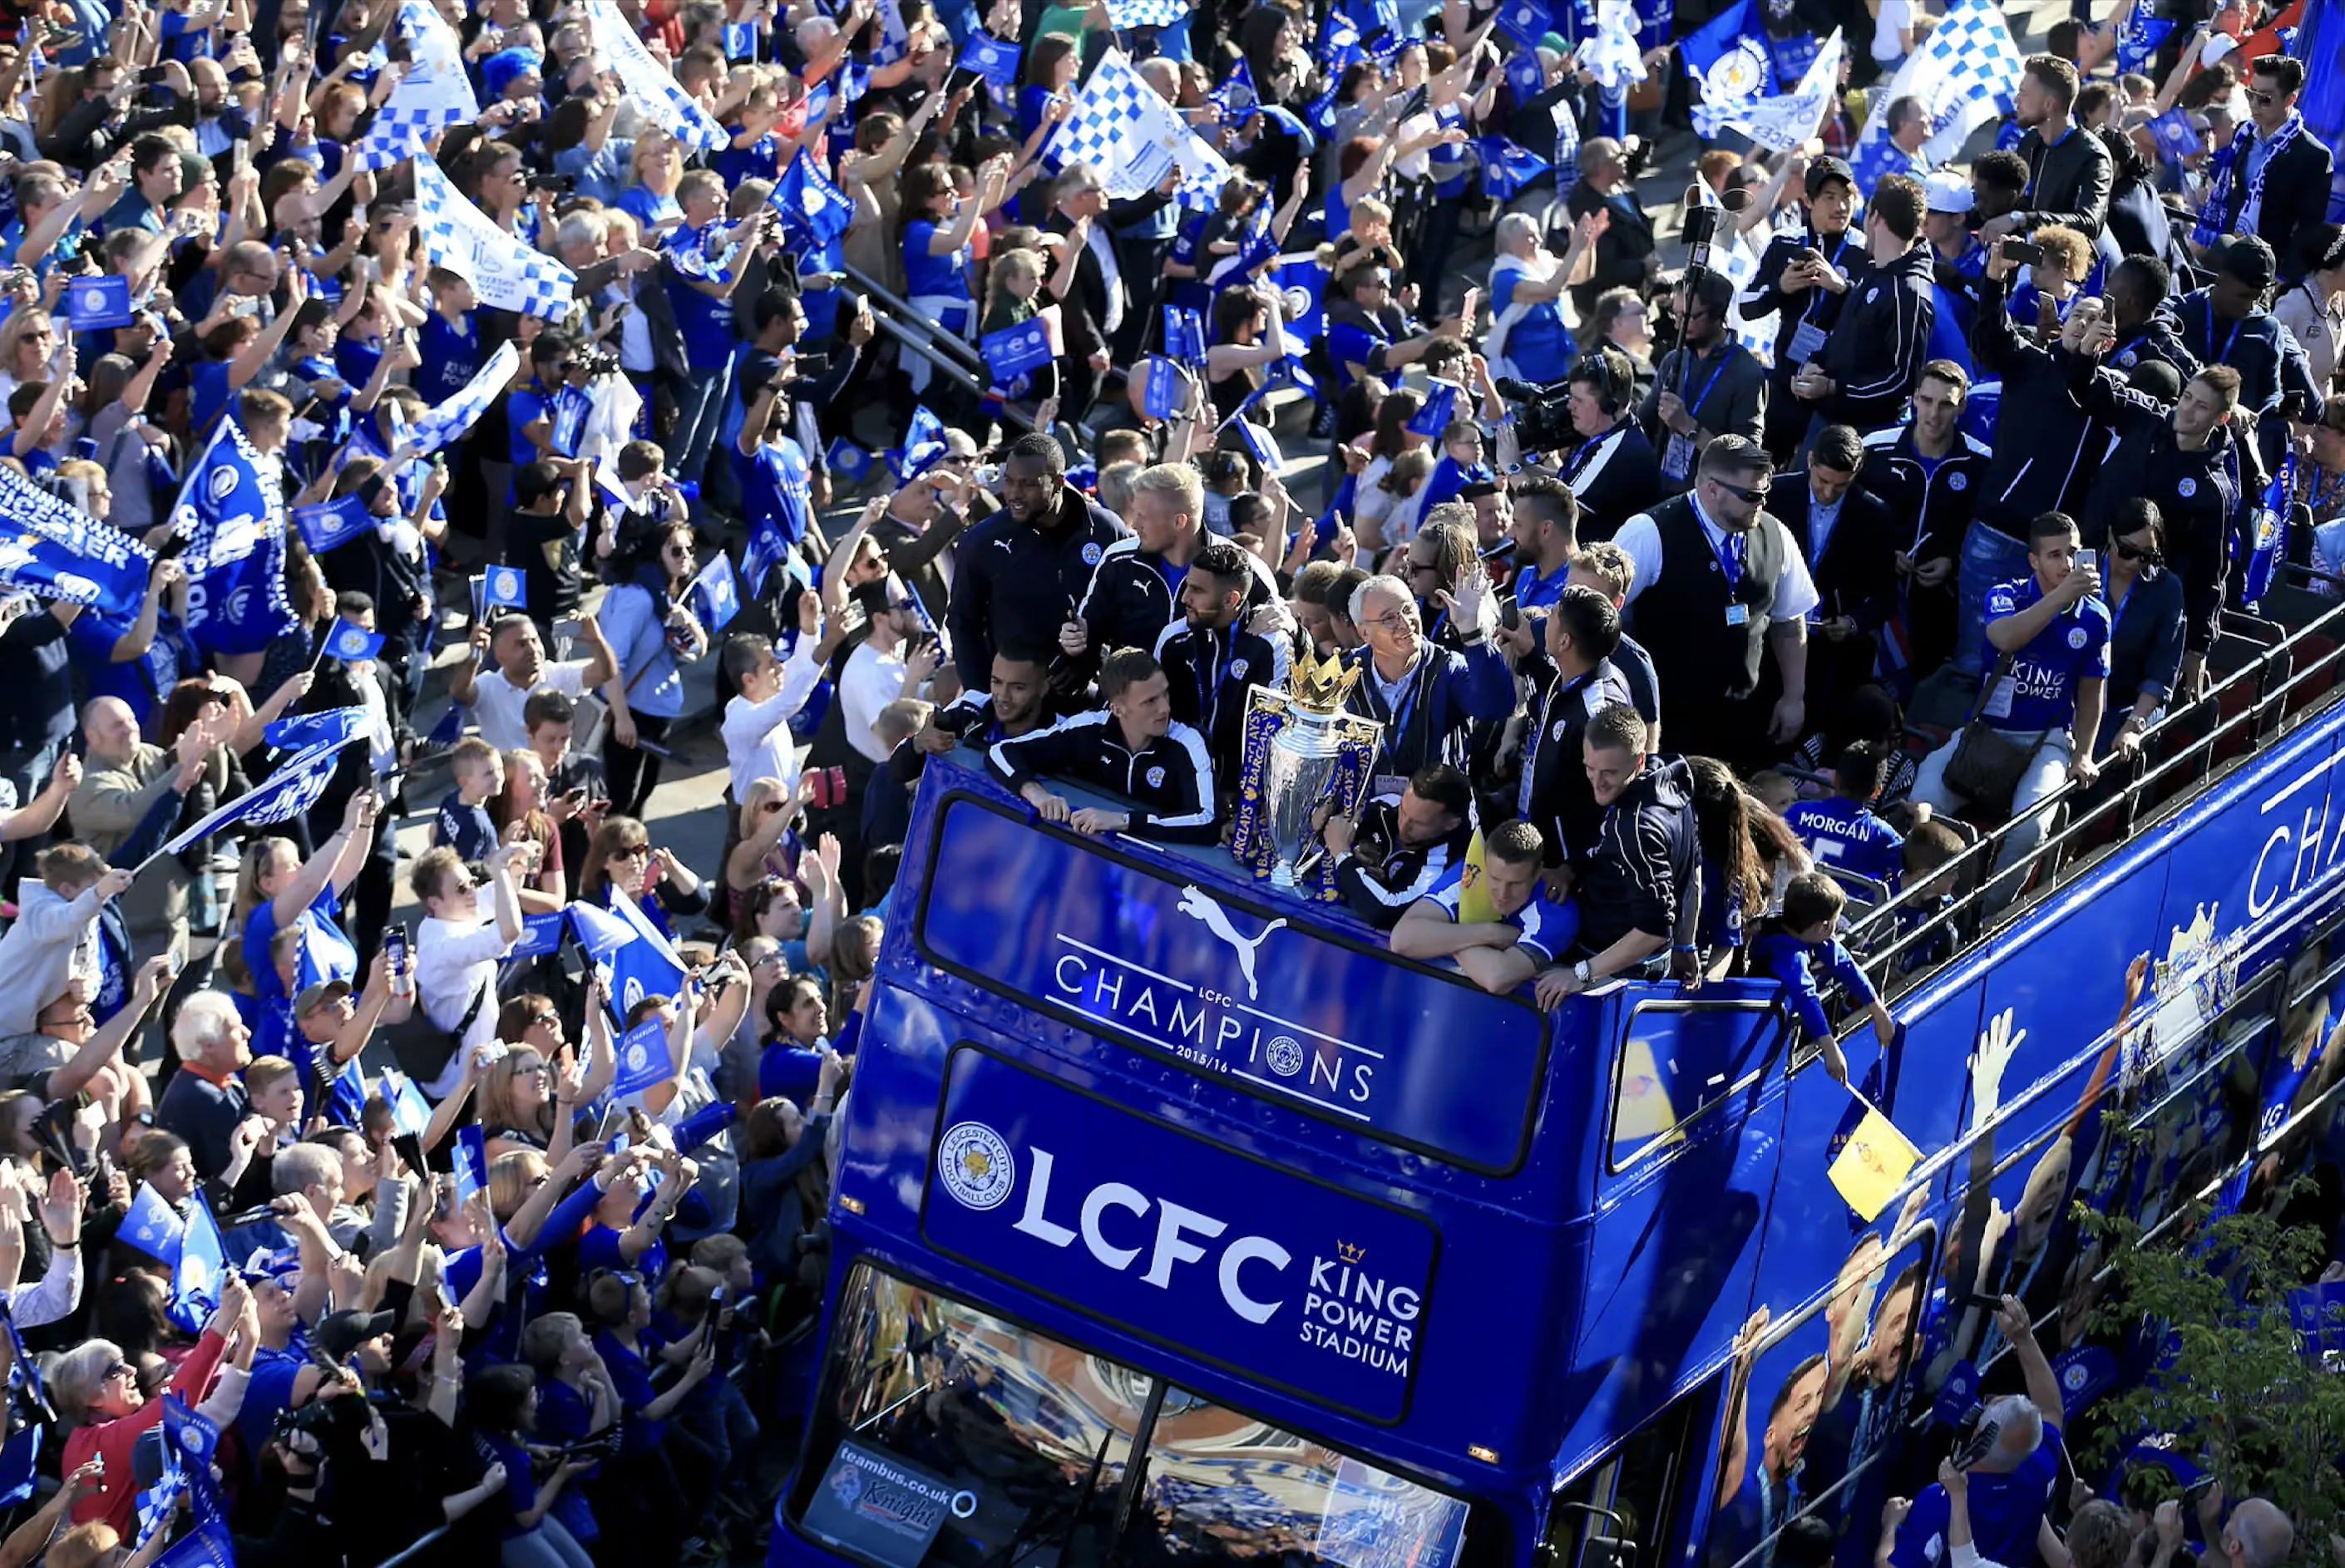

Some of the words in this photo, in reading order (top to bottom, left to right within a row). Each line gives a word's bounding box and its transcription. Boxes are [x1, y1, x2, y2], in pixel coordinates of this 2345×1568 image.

[2011, 660, 2066, 687] KING
[1248, 721, 1276, 786] BARCLAYS
[1799, 811, 1870, 841] MORGAN
[1198, 986, 1232, 1008] LCFC
[1177, 1044, 1228, 1073] 2015/16
[949, 1129, 998, 1151] LEICESTER
[995, 1149, 1009, 1175] CITY
[945, 1157, 983, 1202] FOOTBALL
[984, 1181, 1006, 1201] CLUB
[1012, 1146, 1291, 1324] LCFC
[1310, 1255, 1420, 1320] KING
[1304, 1292, 1412, 1352] POWER
[1300, 1321, 1408, 1378] STADIUM
[841, 1447, 950, 1506] teambus.co.uk
[863, 1481, 937, 1528] Knight
